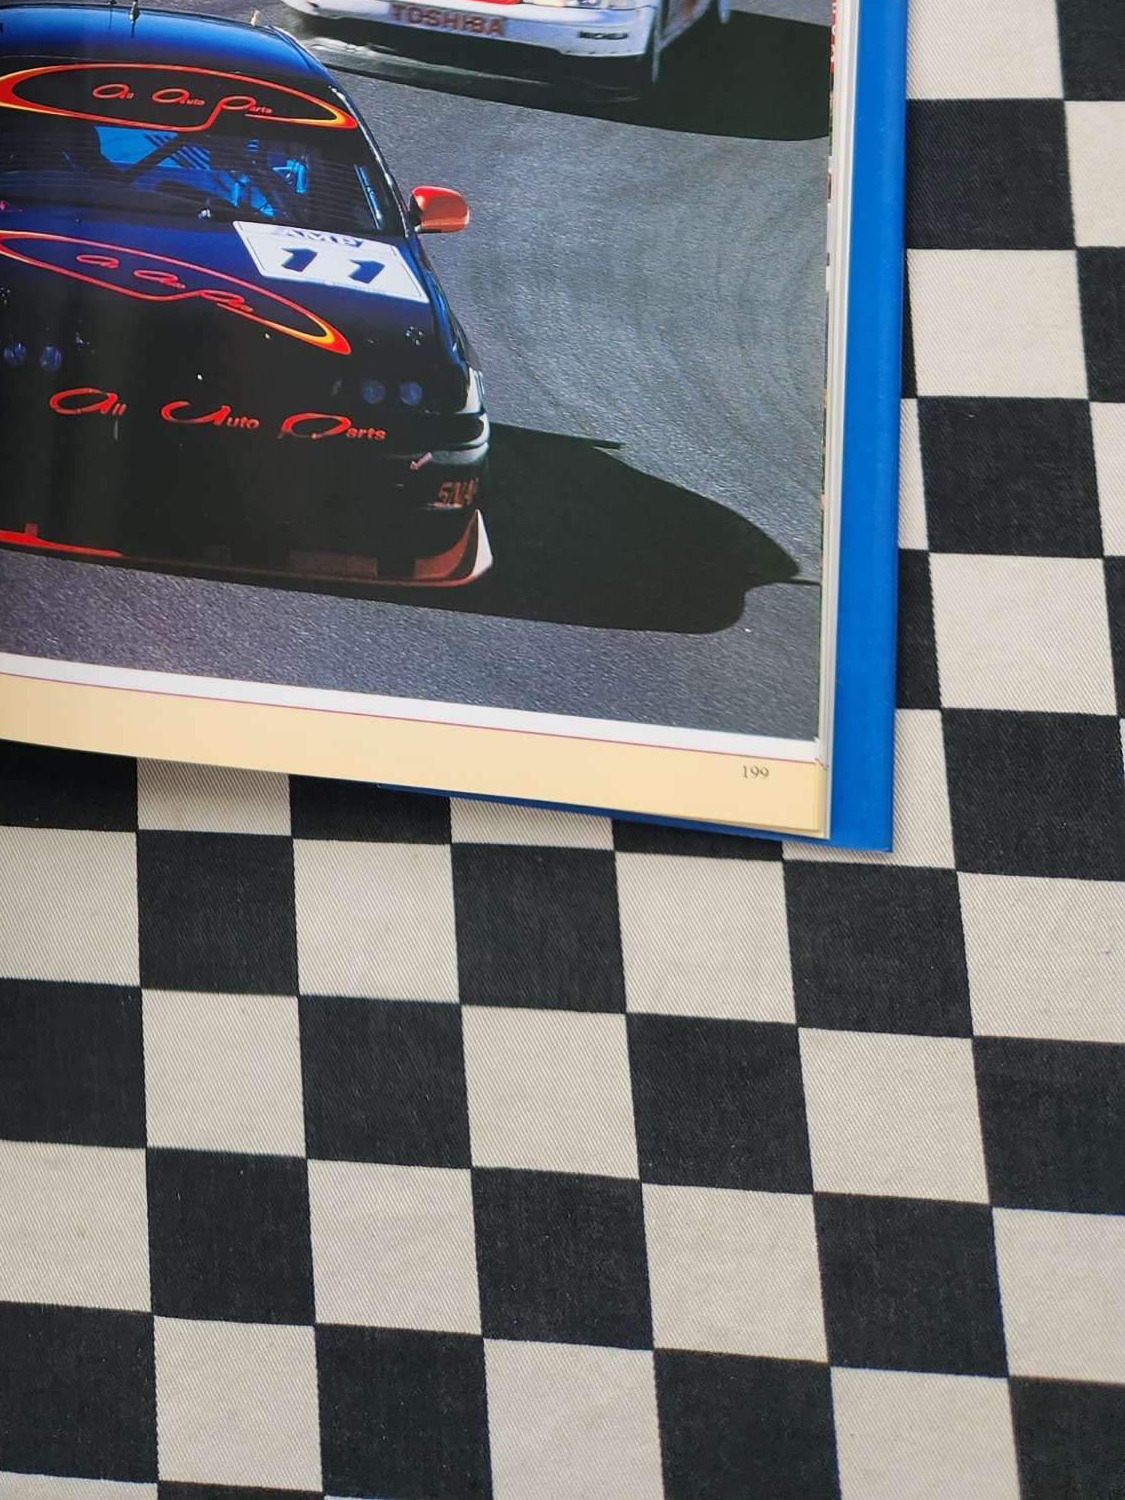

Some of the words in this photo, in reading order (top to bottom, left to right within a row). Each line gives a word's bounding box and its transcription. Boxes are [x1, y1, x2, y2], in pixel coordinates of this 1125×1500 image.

[388, 2, 506, 38] TOSHIBA
[281, 246, 385, 284] 11
[49, 387, 127, 416] All
[161, 401, 260, 430] Auto
[741, 764, 770, 780] 199
